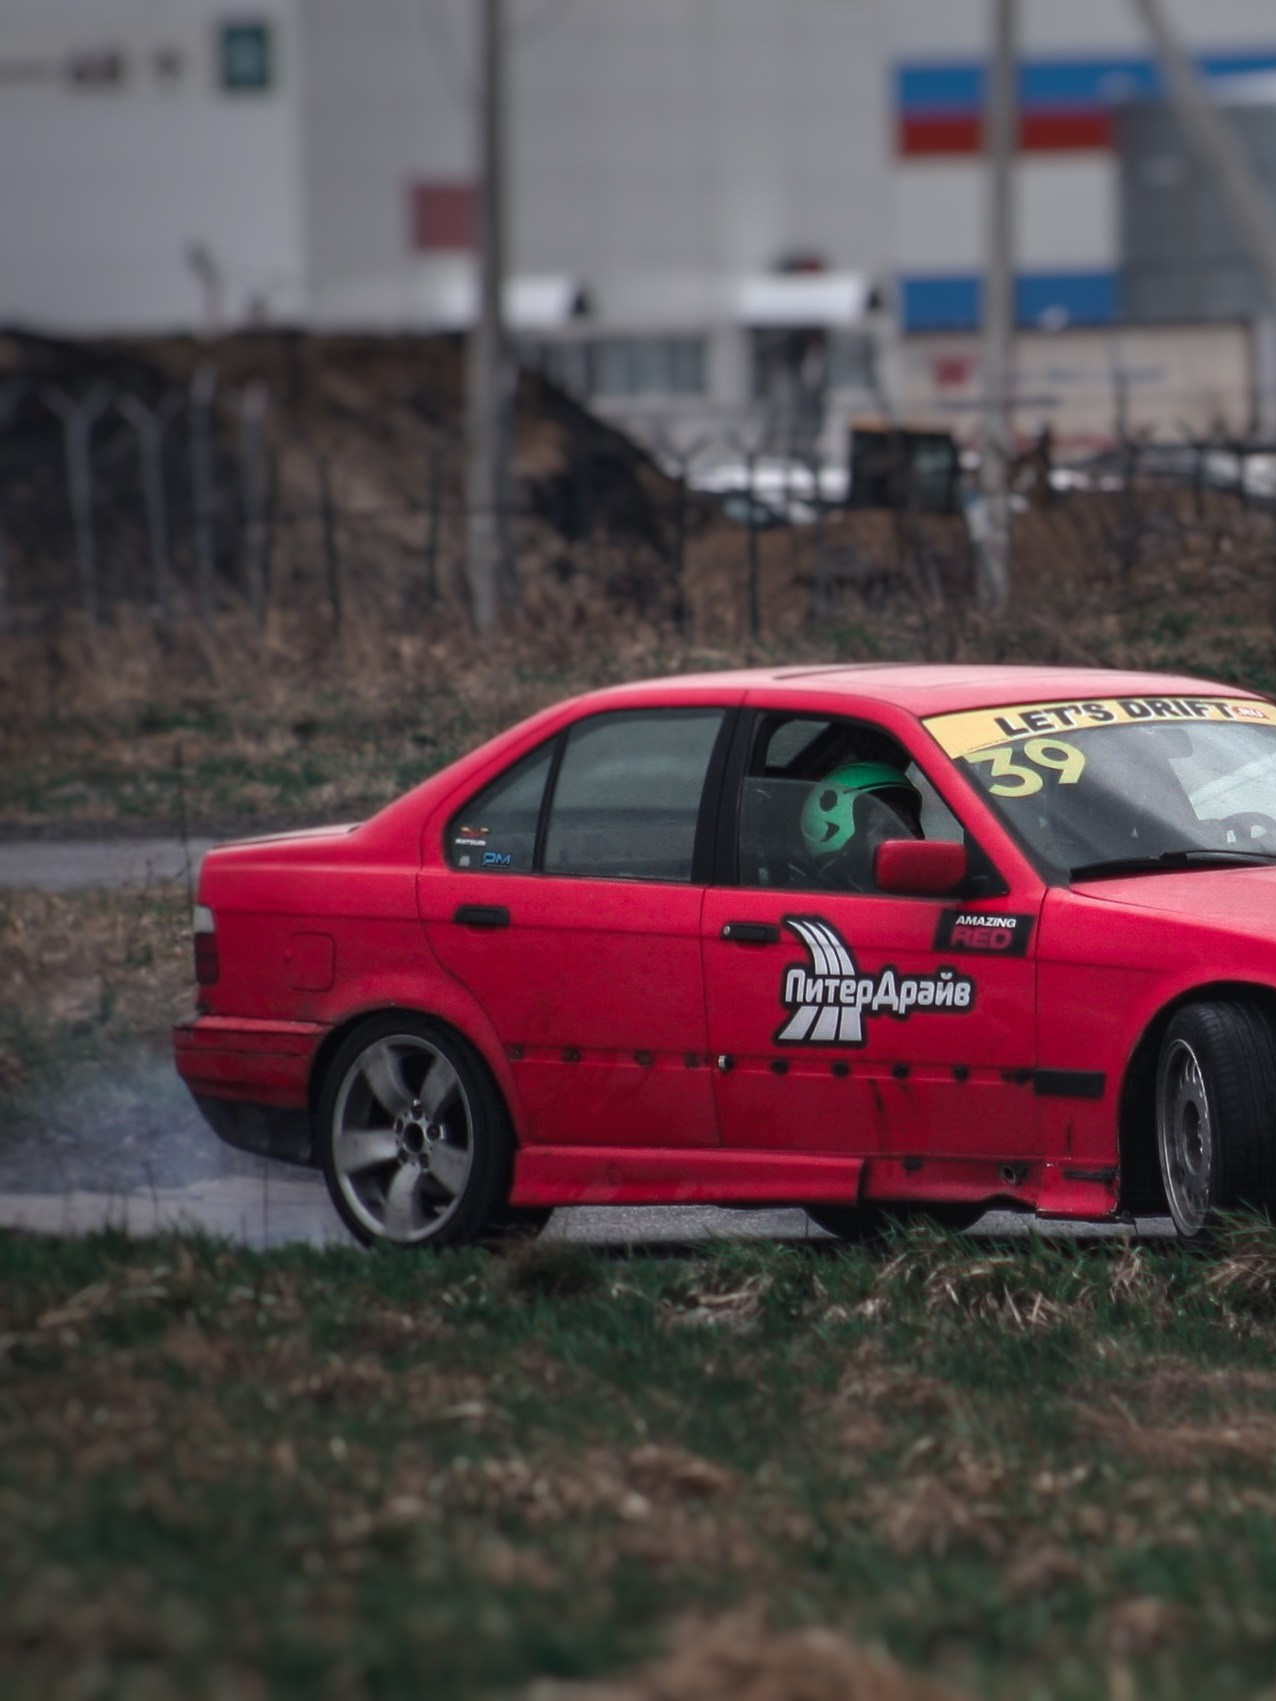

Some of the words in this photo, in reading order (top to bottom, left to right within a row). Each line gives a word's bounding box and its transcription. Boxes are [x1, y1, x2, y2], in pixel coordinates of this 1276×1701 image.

[993, 703, 1117, 738] LET'S
[1117, 699, 1237, 719] DRIFT
[967, 738, 1086, 798] 39
[951, 926, 1013, 949] RED
[955, 915, 1017, 929] AMAZING
[785, 968, 972, 1015] ПитерДрайв
